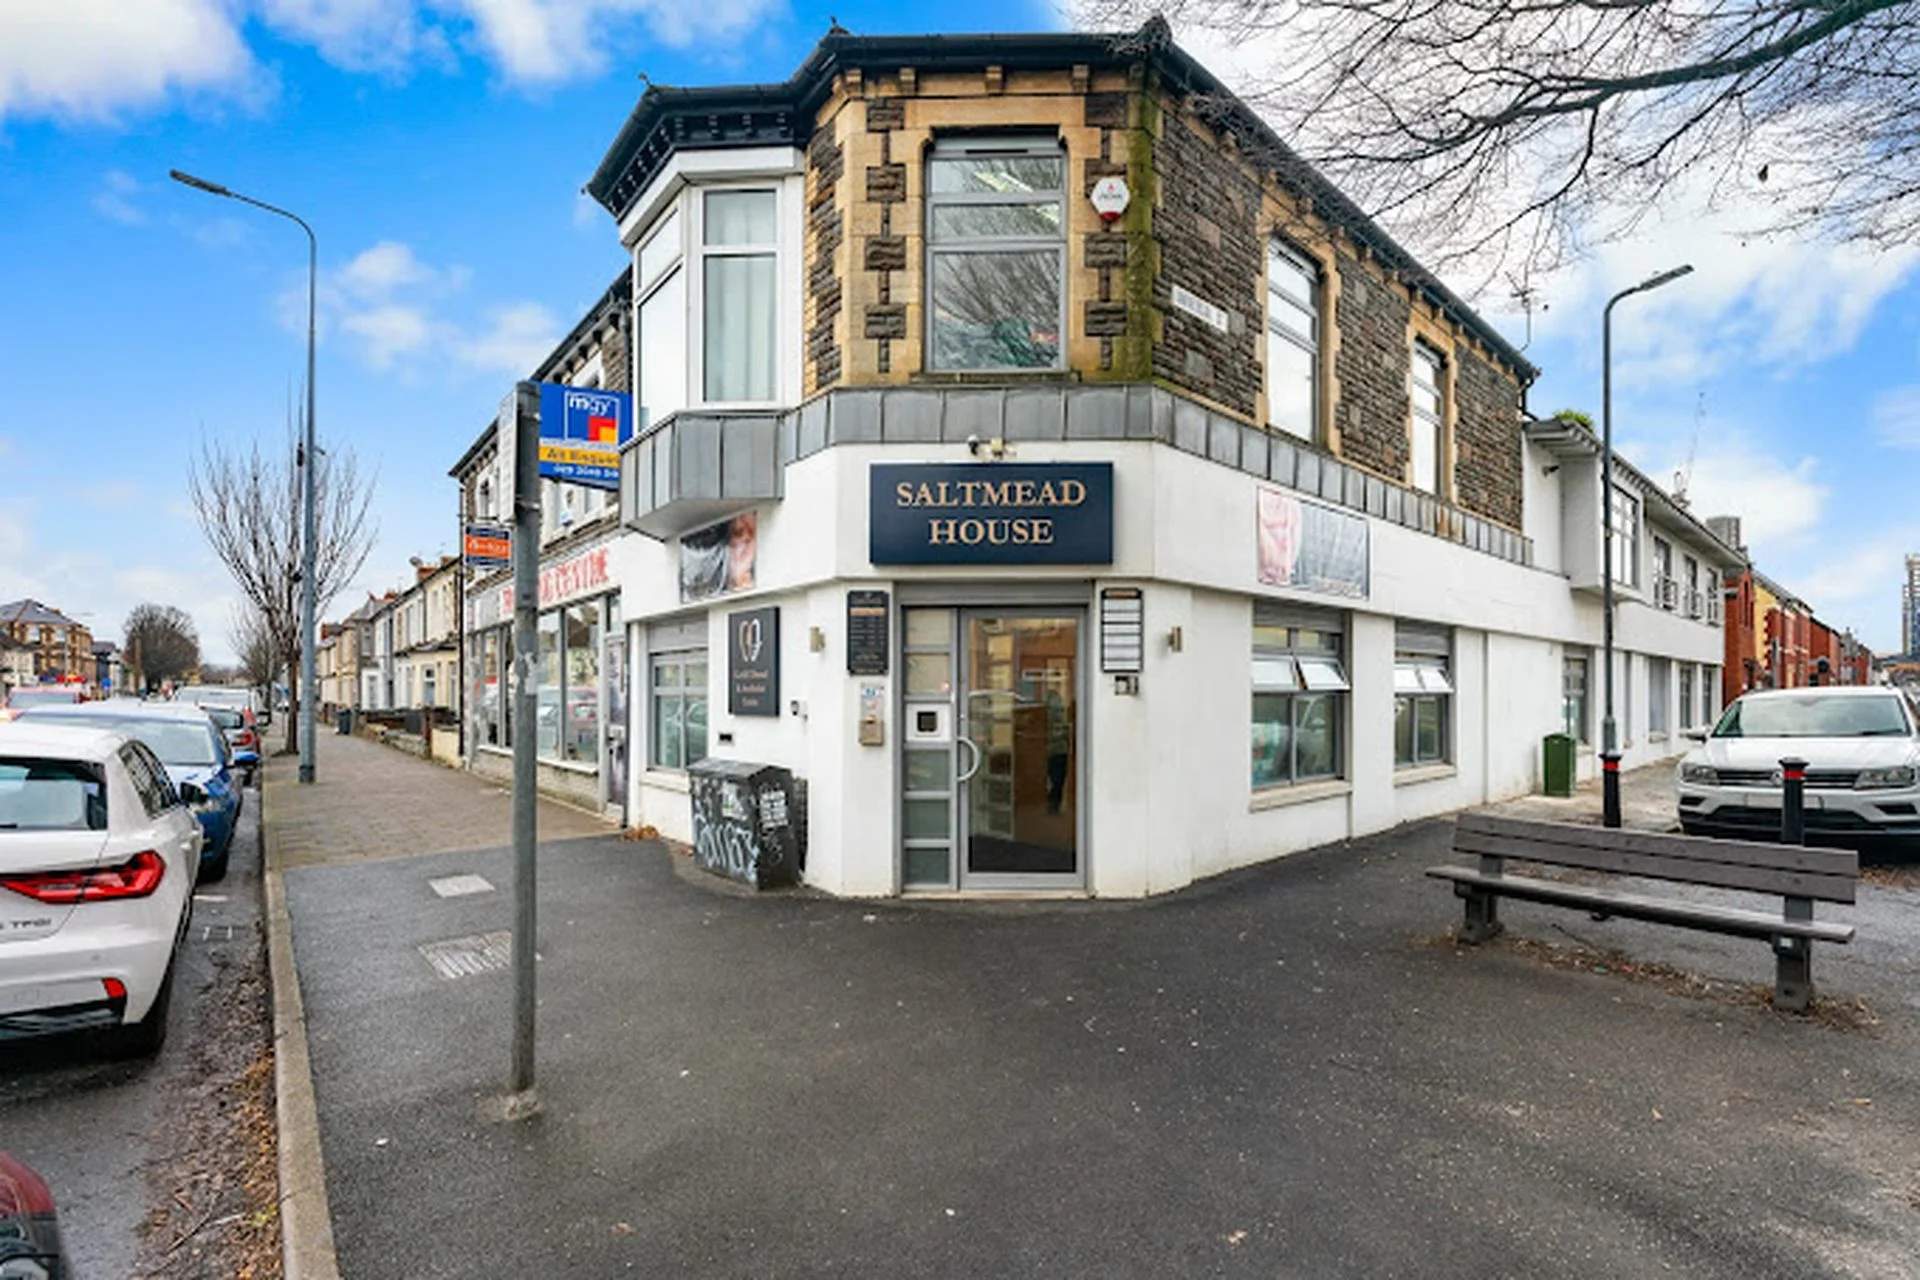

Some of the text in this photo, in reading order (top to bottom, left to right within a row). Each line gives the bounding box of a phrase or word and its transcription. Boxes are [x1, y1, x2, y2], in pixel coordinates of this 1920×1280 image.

[569, 397, 611, 417] mgy
[896, 480, 1087, 507] SALTMEAD
[929, 519, 1054, 544] HOUSE
